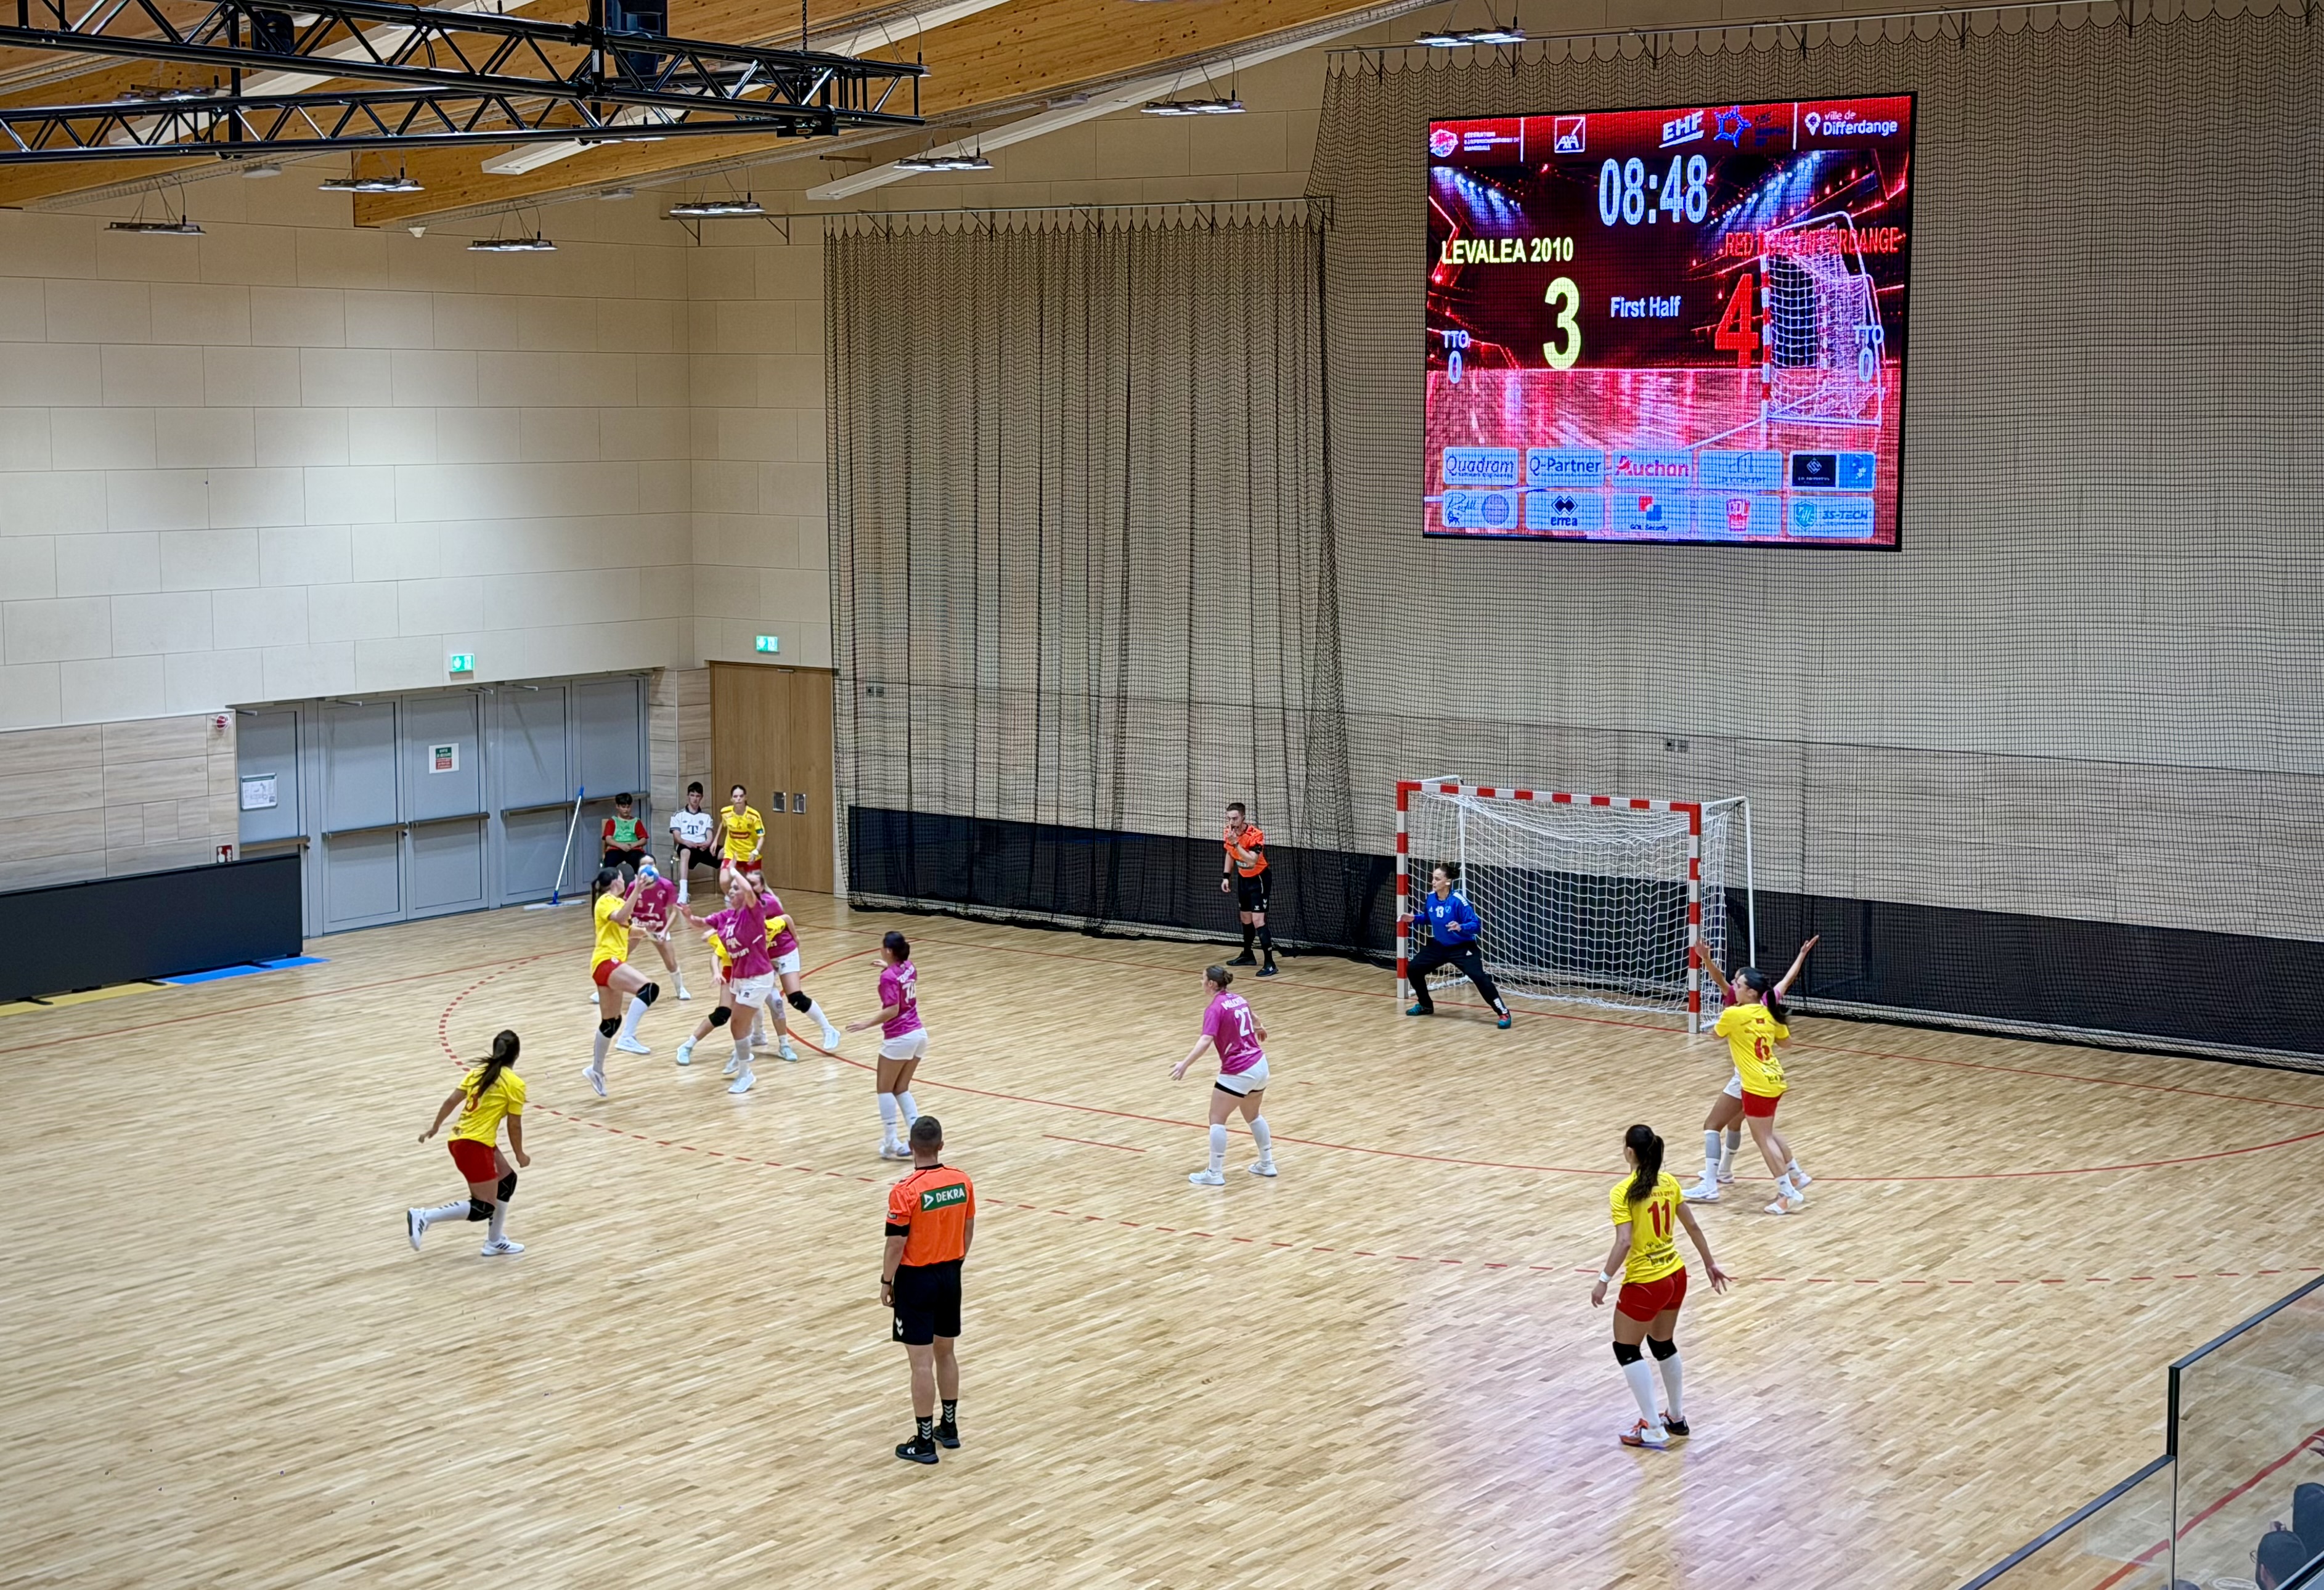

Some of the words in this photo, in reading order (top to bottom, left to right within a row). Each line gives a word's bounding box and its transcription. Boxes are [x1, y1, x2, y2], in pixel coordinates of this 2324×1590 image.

[1663, 111, 1703, 141] EHF
[1825, 112, 1842, 120] ville
[1844, 111, 1856, 120] de
[1823, 120, 1898, 137] Differdange
[1555, 134, 1580, 149] AXA
[1599, 154, 1708, 227] 08:48
[1441, 238, 1527, 264] LEVALEA
[1531, 237, 1573, 263] 2010
[1726, 232, 1754, 256] RED
[1610, 297, 1645, 318] First
[1649, 296, 1681, 317] Half
[1543, 277, 1582, 370] 3
[1714, 274, 1759, 369] 4
[1442, 330, 1469, 349] TTO
[1853, 325, 1885, 345] TTO
[1448, 350, 1462, 384] 0
[1858, 348, 1874, 383] 0
[1446, 455, 1514, 476] Quadram
[1529, 455, 1600, 476] Q-Partner
[1615, 455, 1689, 476] Auchan
[647, 902, 654, 913] 7
[1435, 906, 1444, 918] 13
[1234, 1006, 1254, 1037] 27
[1755, 1036, 1770, 1061] 6
[936, 1188, 965, 1203] DEKRA
[1647, 1199, 1670, 1238] 11
